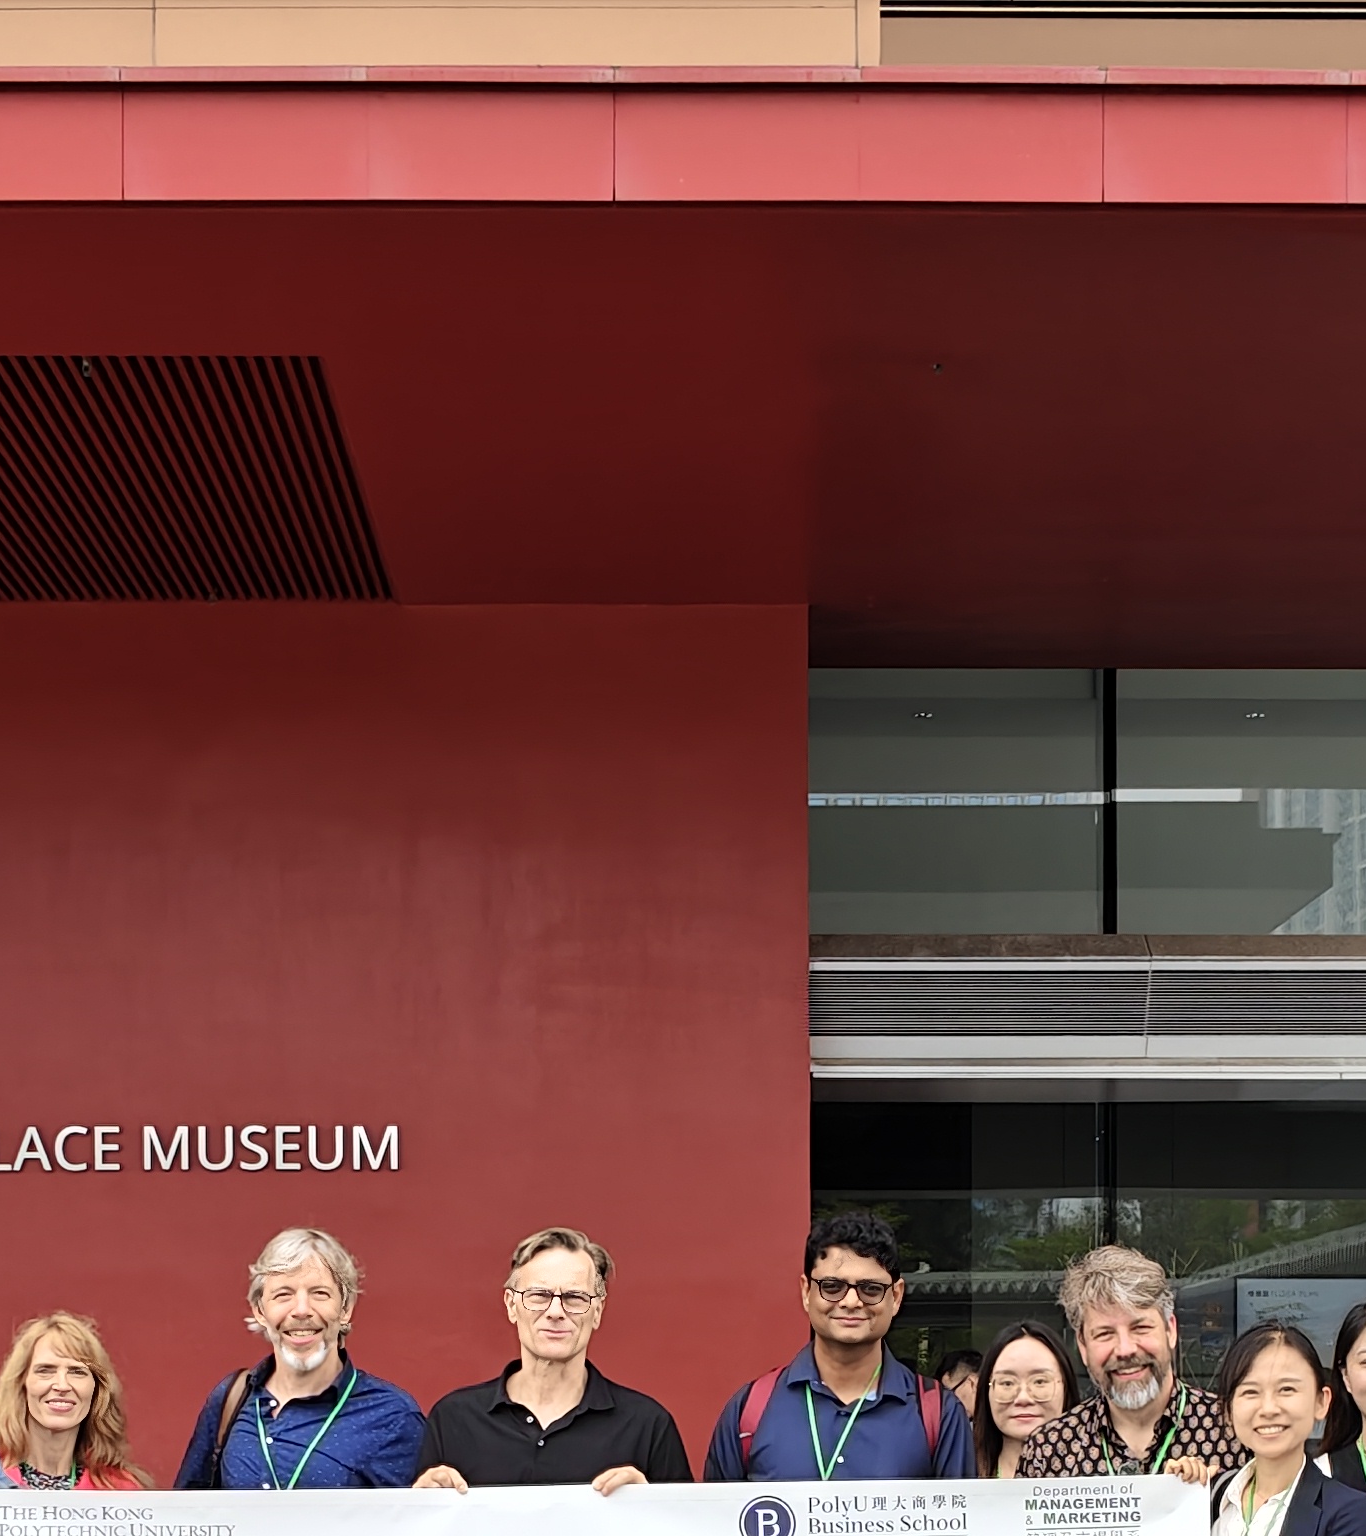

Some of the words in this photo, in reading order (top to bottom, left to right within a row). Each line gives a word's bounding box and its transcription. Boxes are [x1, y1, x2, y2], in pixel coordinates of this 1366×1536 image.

[142, 1124, 400, 1171] MUSEUM
[1032, 1485, 1116, 1498] Department
[1119, 1483, 1134, 1495] of
[807, 1495, 868, 1518] PolyU
[871, 1494, 967, 1511] 理大商學院
[1024, 1497, 1142, 1511] MANAGEMENT
[41, 1506, 98, 1521] HONG
[101, 1506, 154, 1521] KONG
[1025, 1514, 1034, 1526] &
[1043, 1511, 1142, 1525] MARKETING
[808, 1516, 895, 1535] Business
[899, 1512, 968, 1532] School
